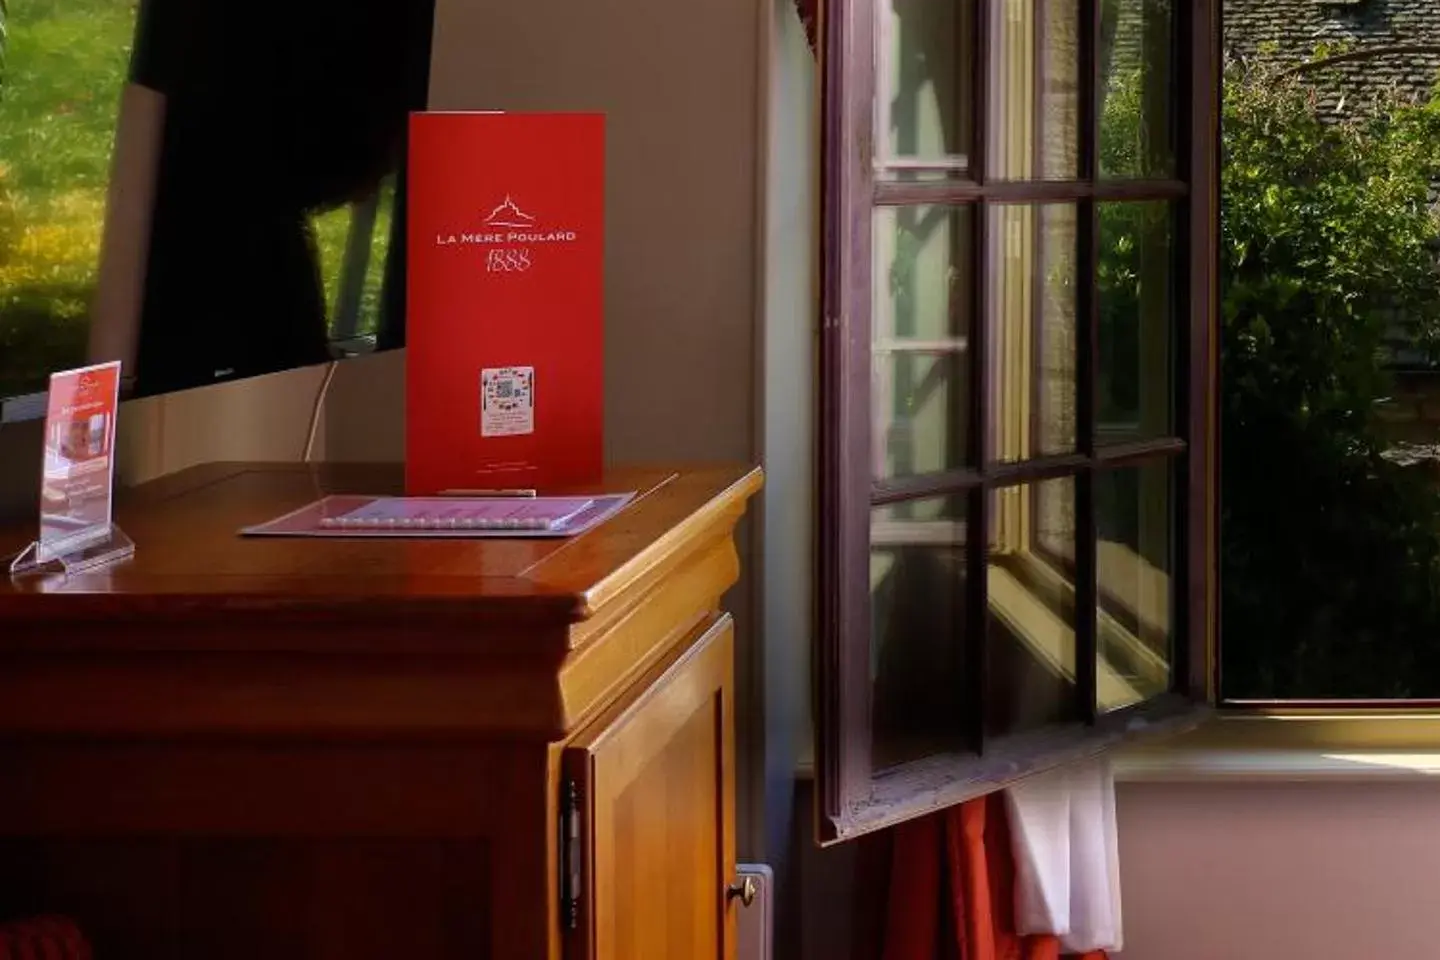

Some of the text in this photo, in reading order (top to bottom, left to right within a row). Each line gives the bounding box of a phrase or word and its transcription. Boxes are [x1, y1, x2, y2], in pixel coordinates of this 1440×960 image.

[436, 233, 457, 244] LA
[506, 231, 576, 243] POULARD
[486, 247, 531, 272] 1888
